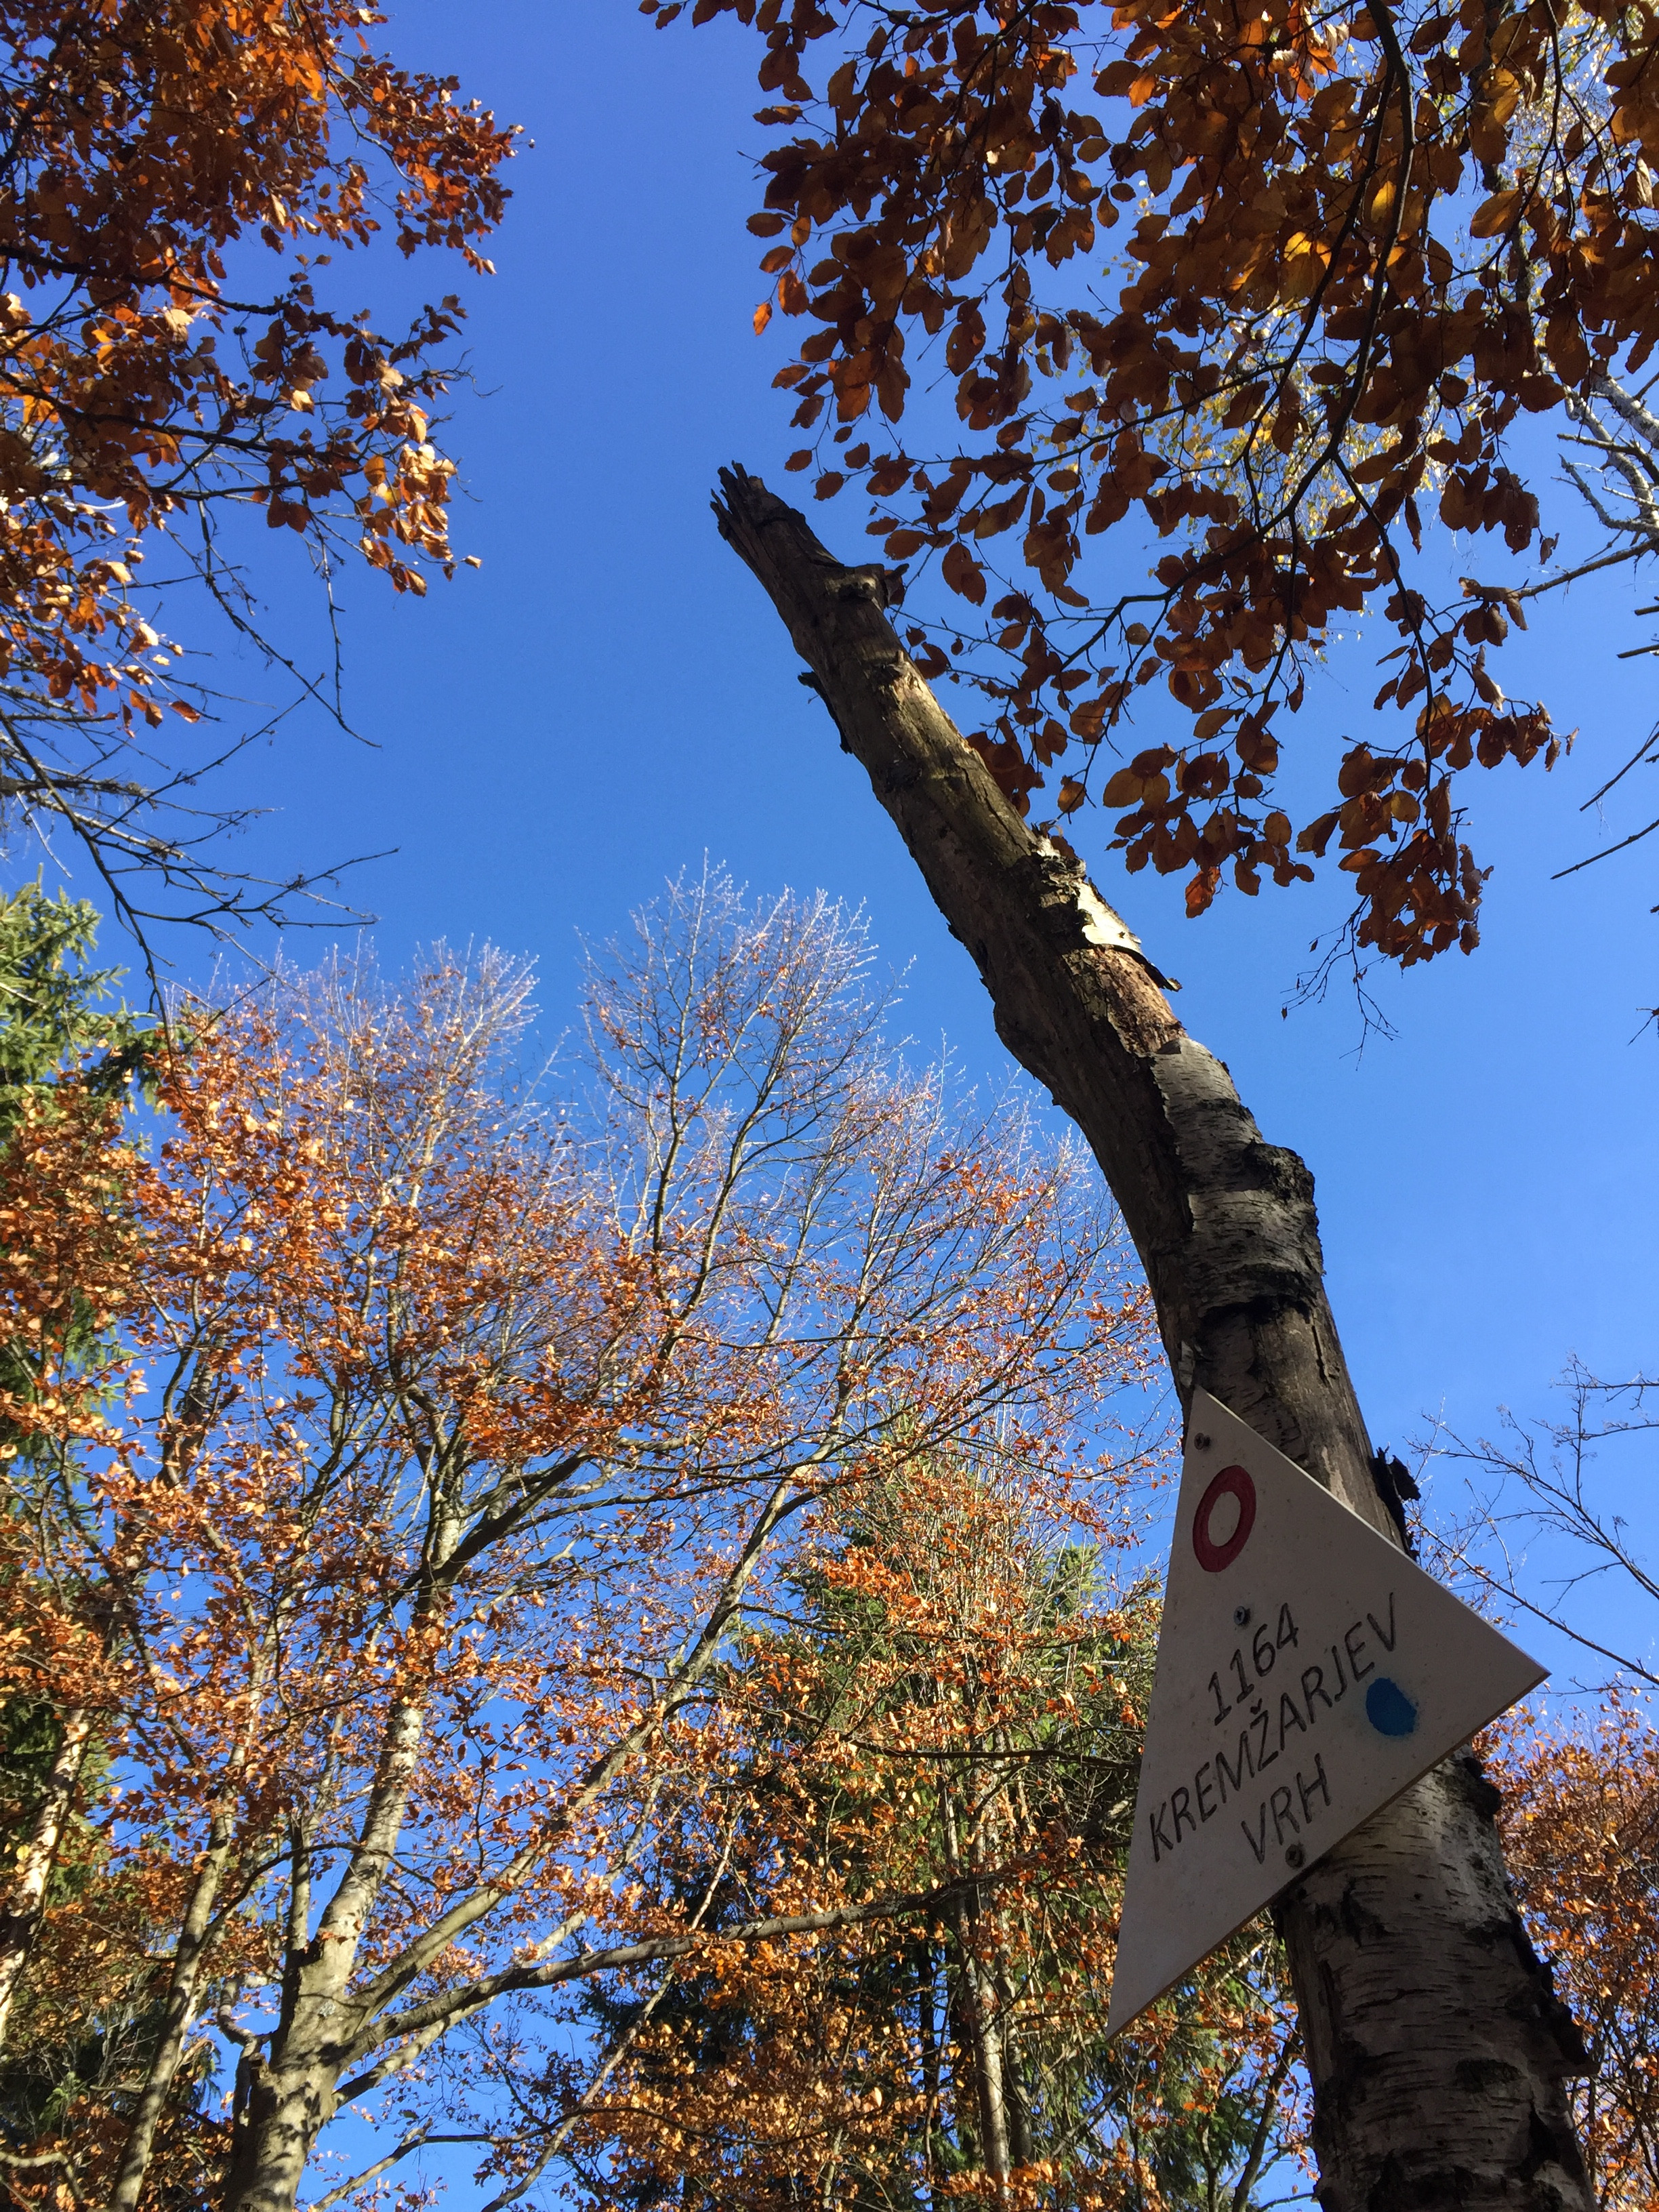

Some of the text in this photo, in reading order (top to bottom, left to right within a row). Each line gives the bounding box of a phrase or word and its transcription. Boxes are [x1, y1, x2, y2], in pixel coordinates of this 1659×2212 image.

[1208, 1602, 1299, 1725] 1164
[1149, 1592, 1397, 1862] KREMŽARJEV
[1240, 1754, 1331, 1864] VRH
